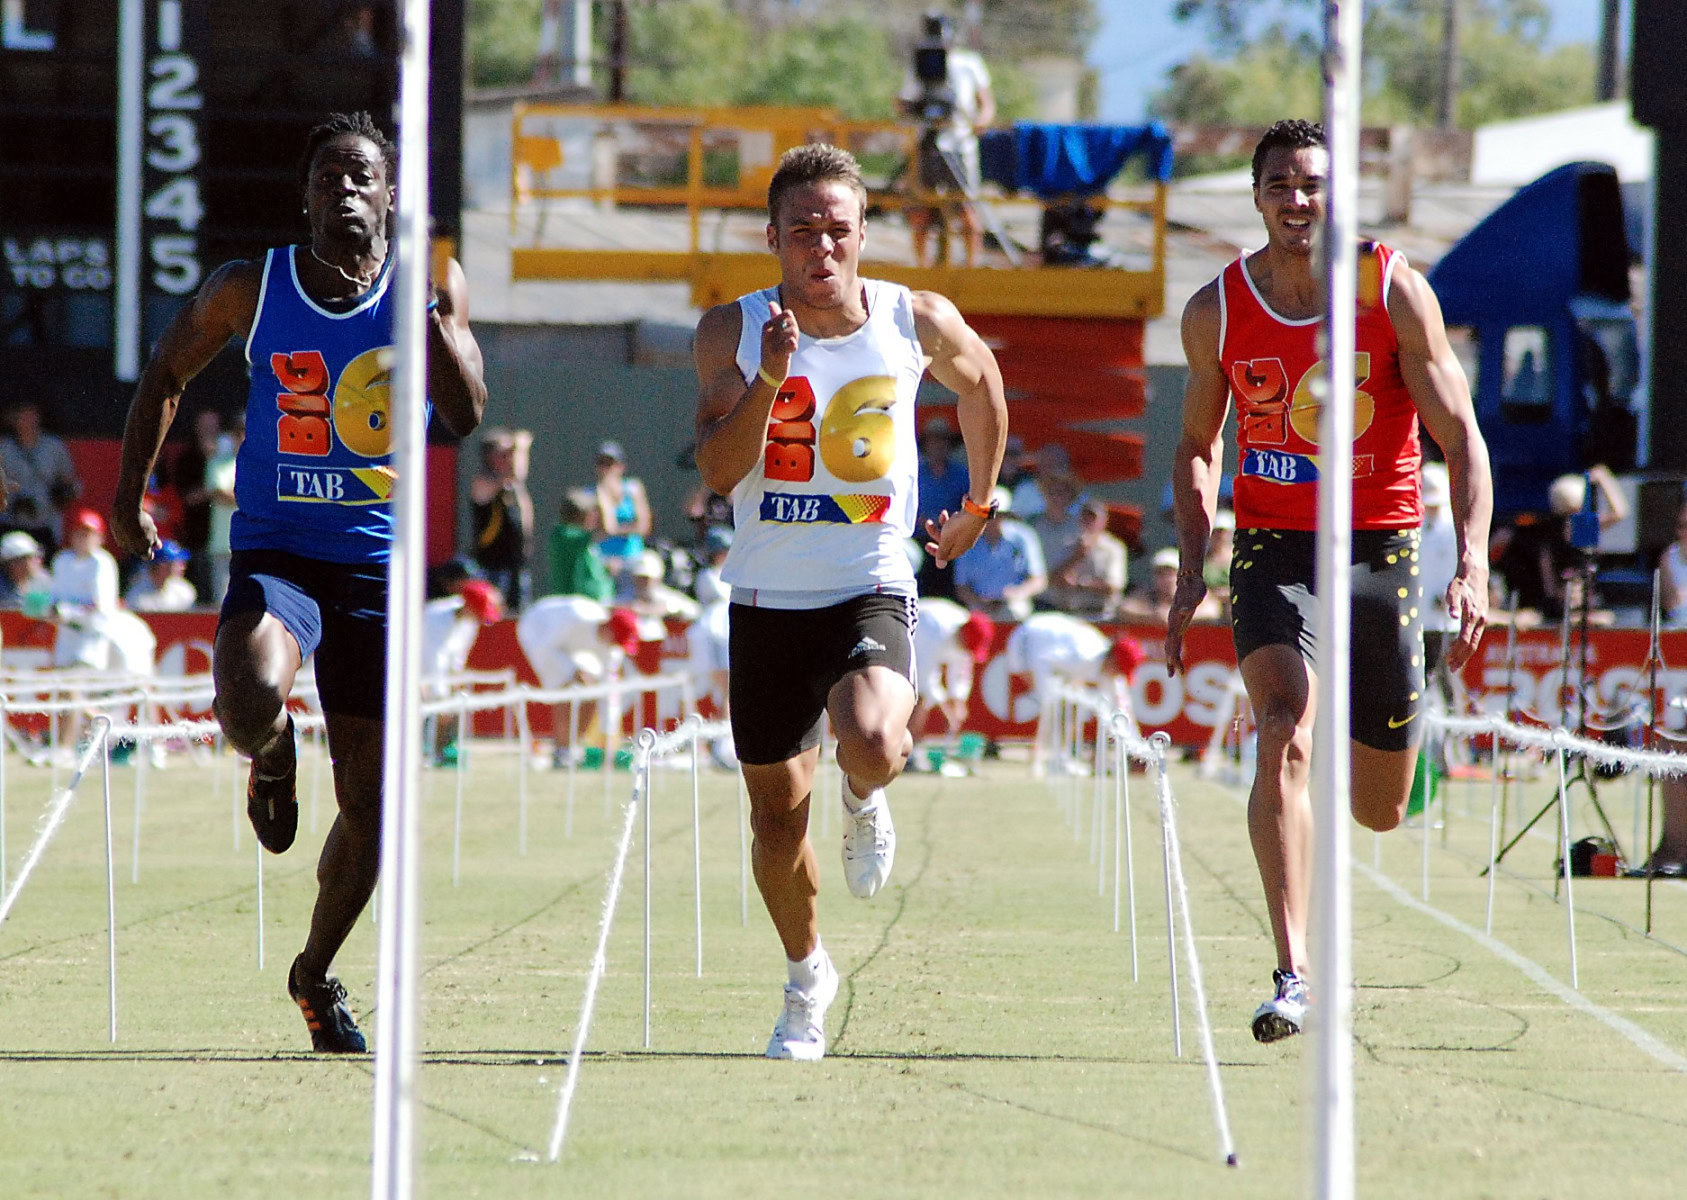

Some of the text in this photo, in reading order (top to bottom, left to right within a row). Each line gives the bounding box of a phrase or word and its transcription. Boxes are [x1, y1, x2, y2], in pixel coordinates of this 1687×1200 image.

[149, 54, 203, 109] 2
[145, 115, 201, 172] 3
[144, 178, 205, 230] 4
[4, 238, 107, 264] LAPS
[152, 236, 200, 294] 5
[12, 267, 112, 289] TO GO
[270, 350, 332, 457] BIG
[333, 345, 397, 458] 6
[819, 375, 898, 484] 6
[290, 471, 344, 500] TAB
[1255, 450, 1298, 481] TAB
[771, 496, 822, 522] TAB
